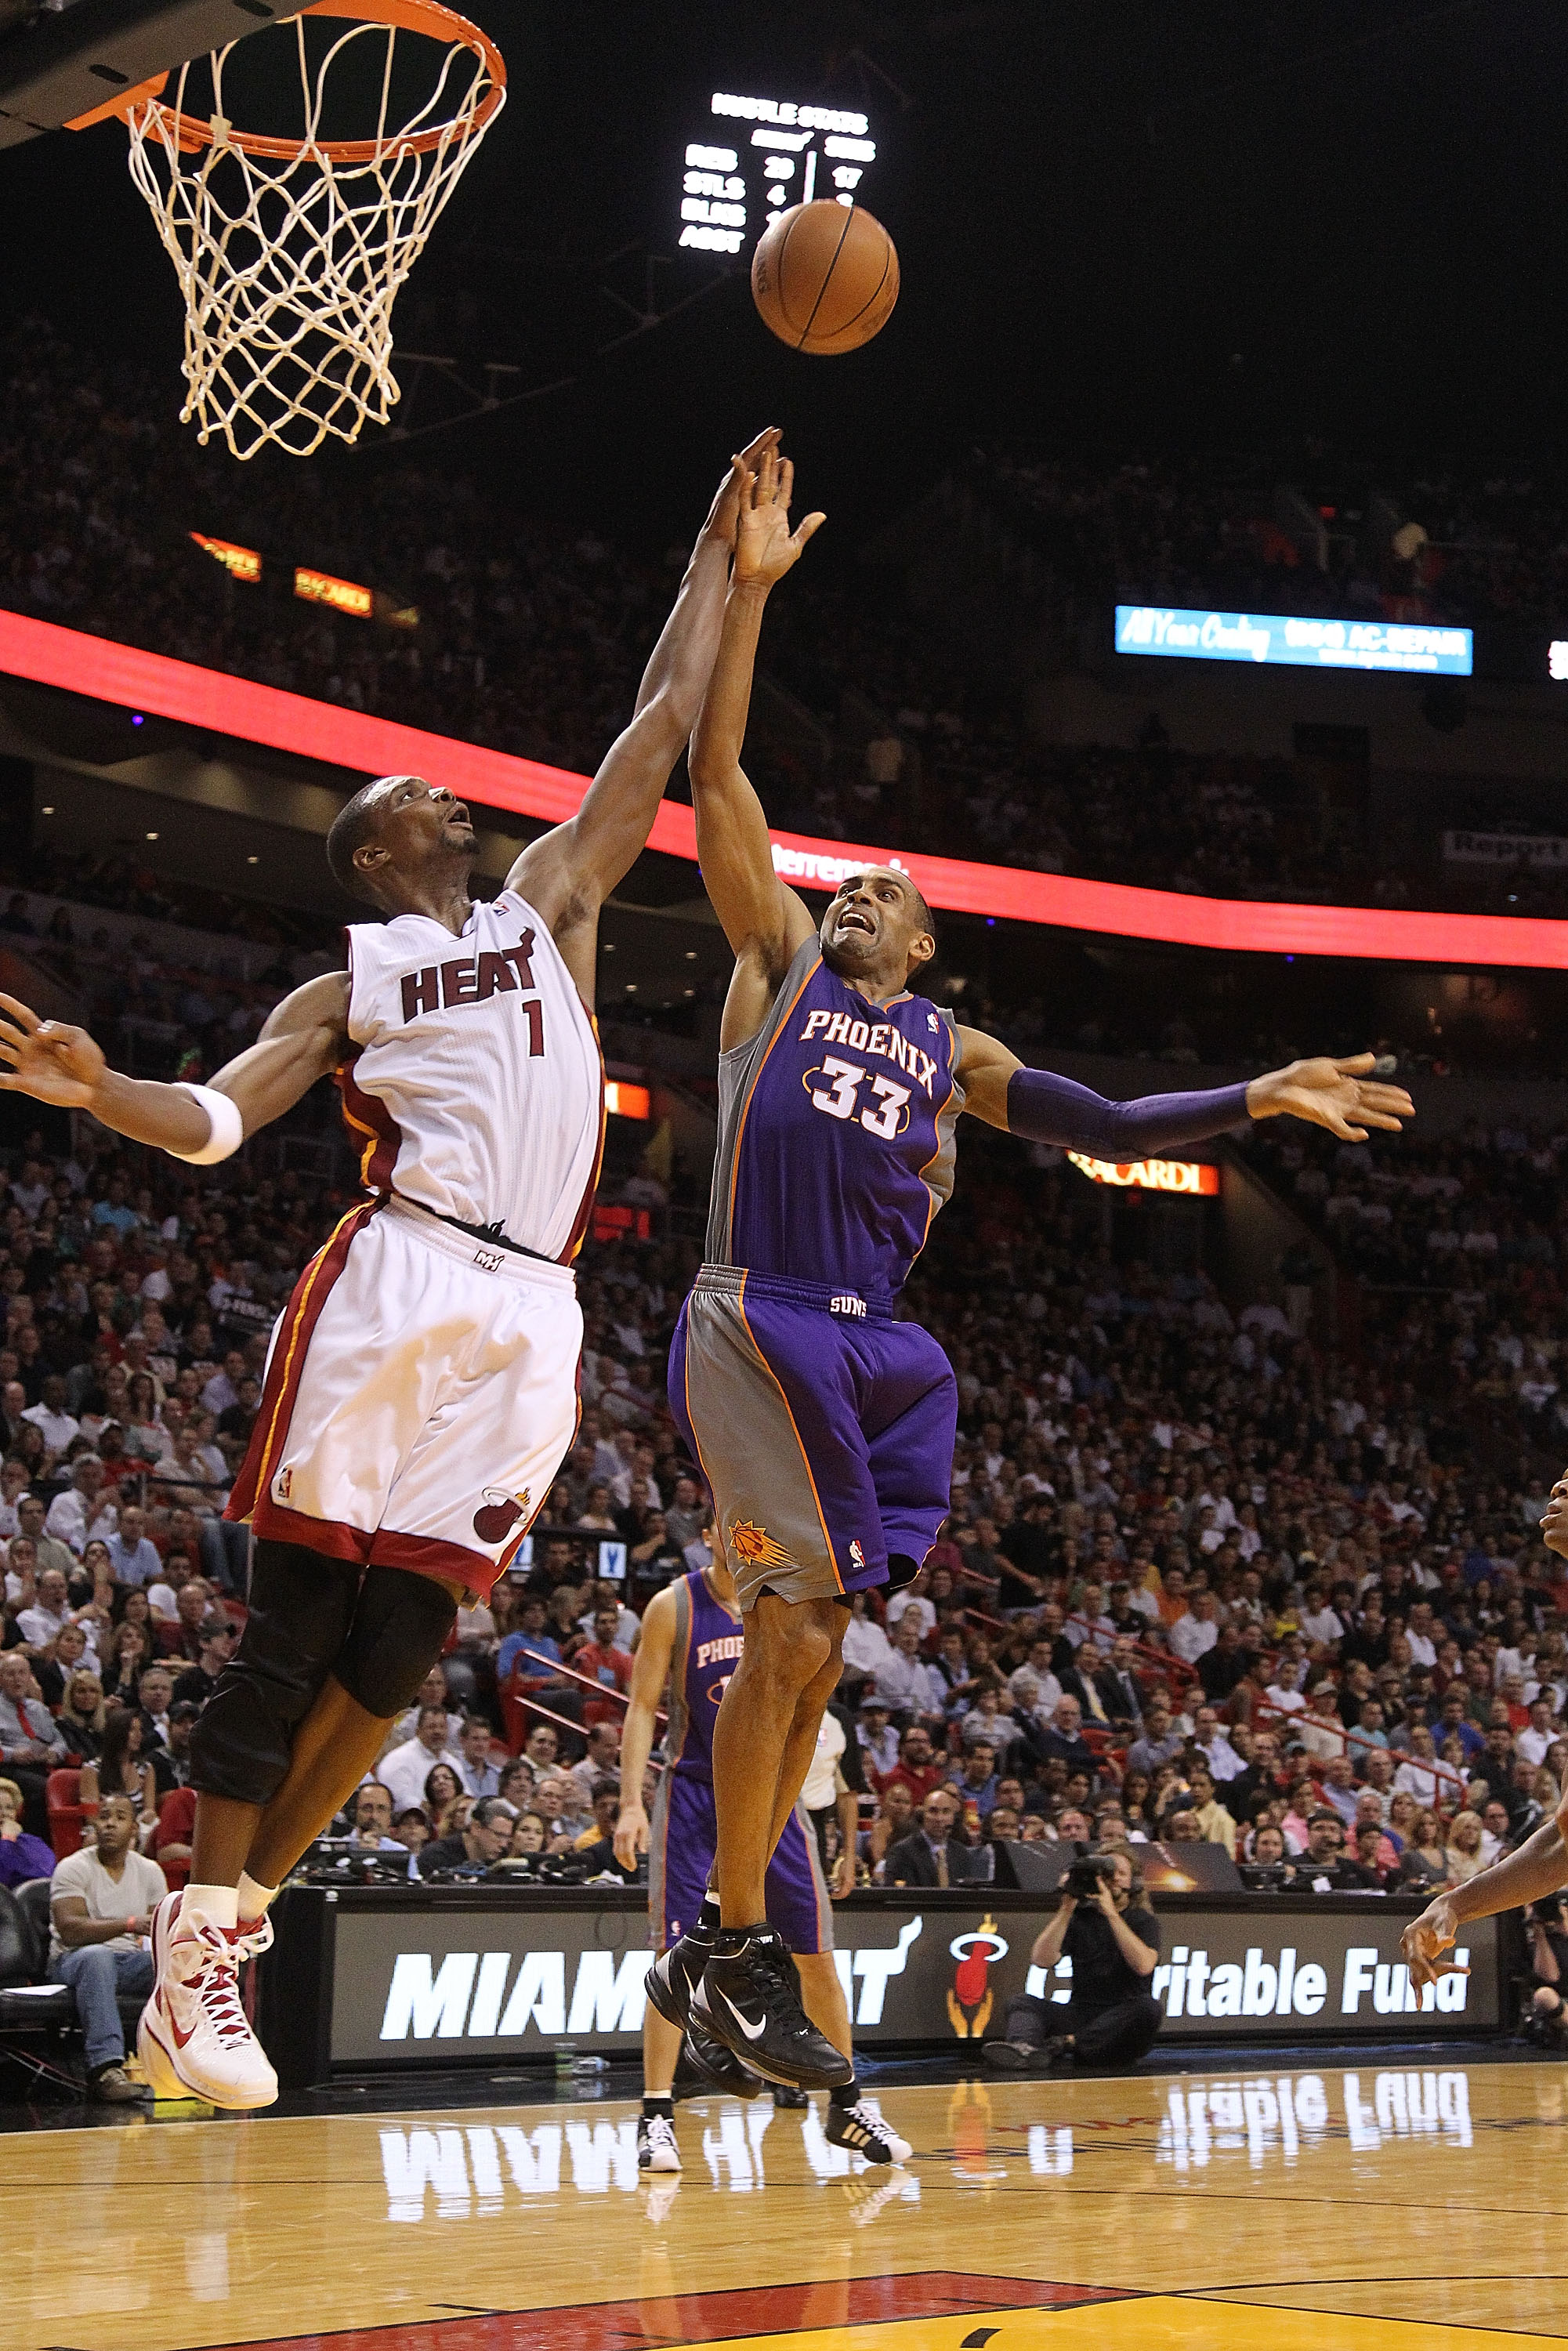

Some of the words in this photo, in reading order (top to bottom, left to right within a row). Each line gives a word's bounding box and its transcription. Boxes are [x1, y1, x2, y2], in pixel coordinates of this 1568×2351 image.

[400, 926, 536, 1025] HEAT
[522, 998, 545, 1057] 1
[798, 1009, 938, 1100] PHOENIX
[811, 1054, 912, 1141] 33
[830, 1295, 867, 1317] SUNS
[697, 1635, 744, 1669] PHOE
[379, 1949, 657, 2041] MIAM
[1025, 1946, 1327, 2018] Critable
